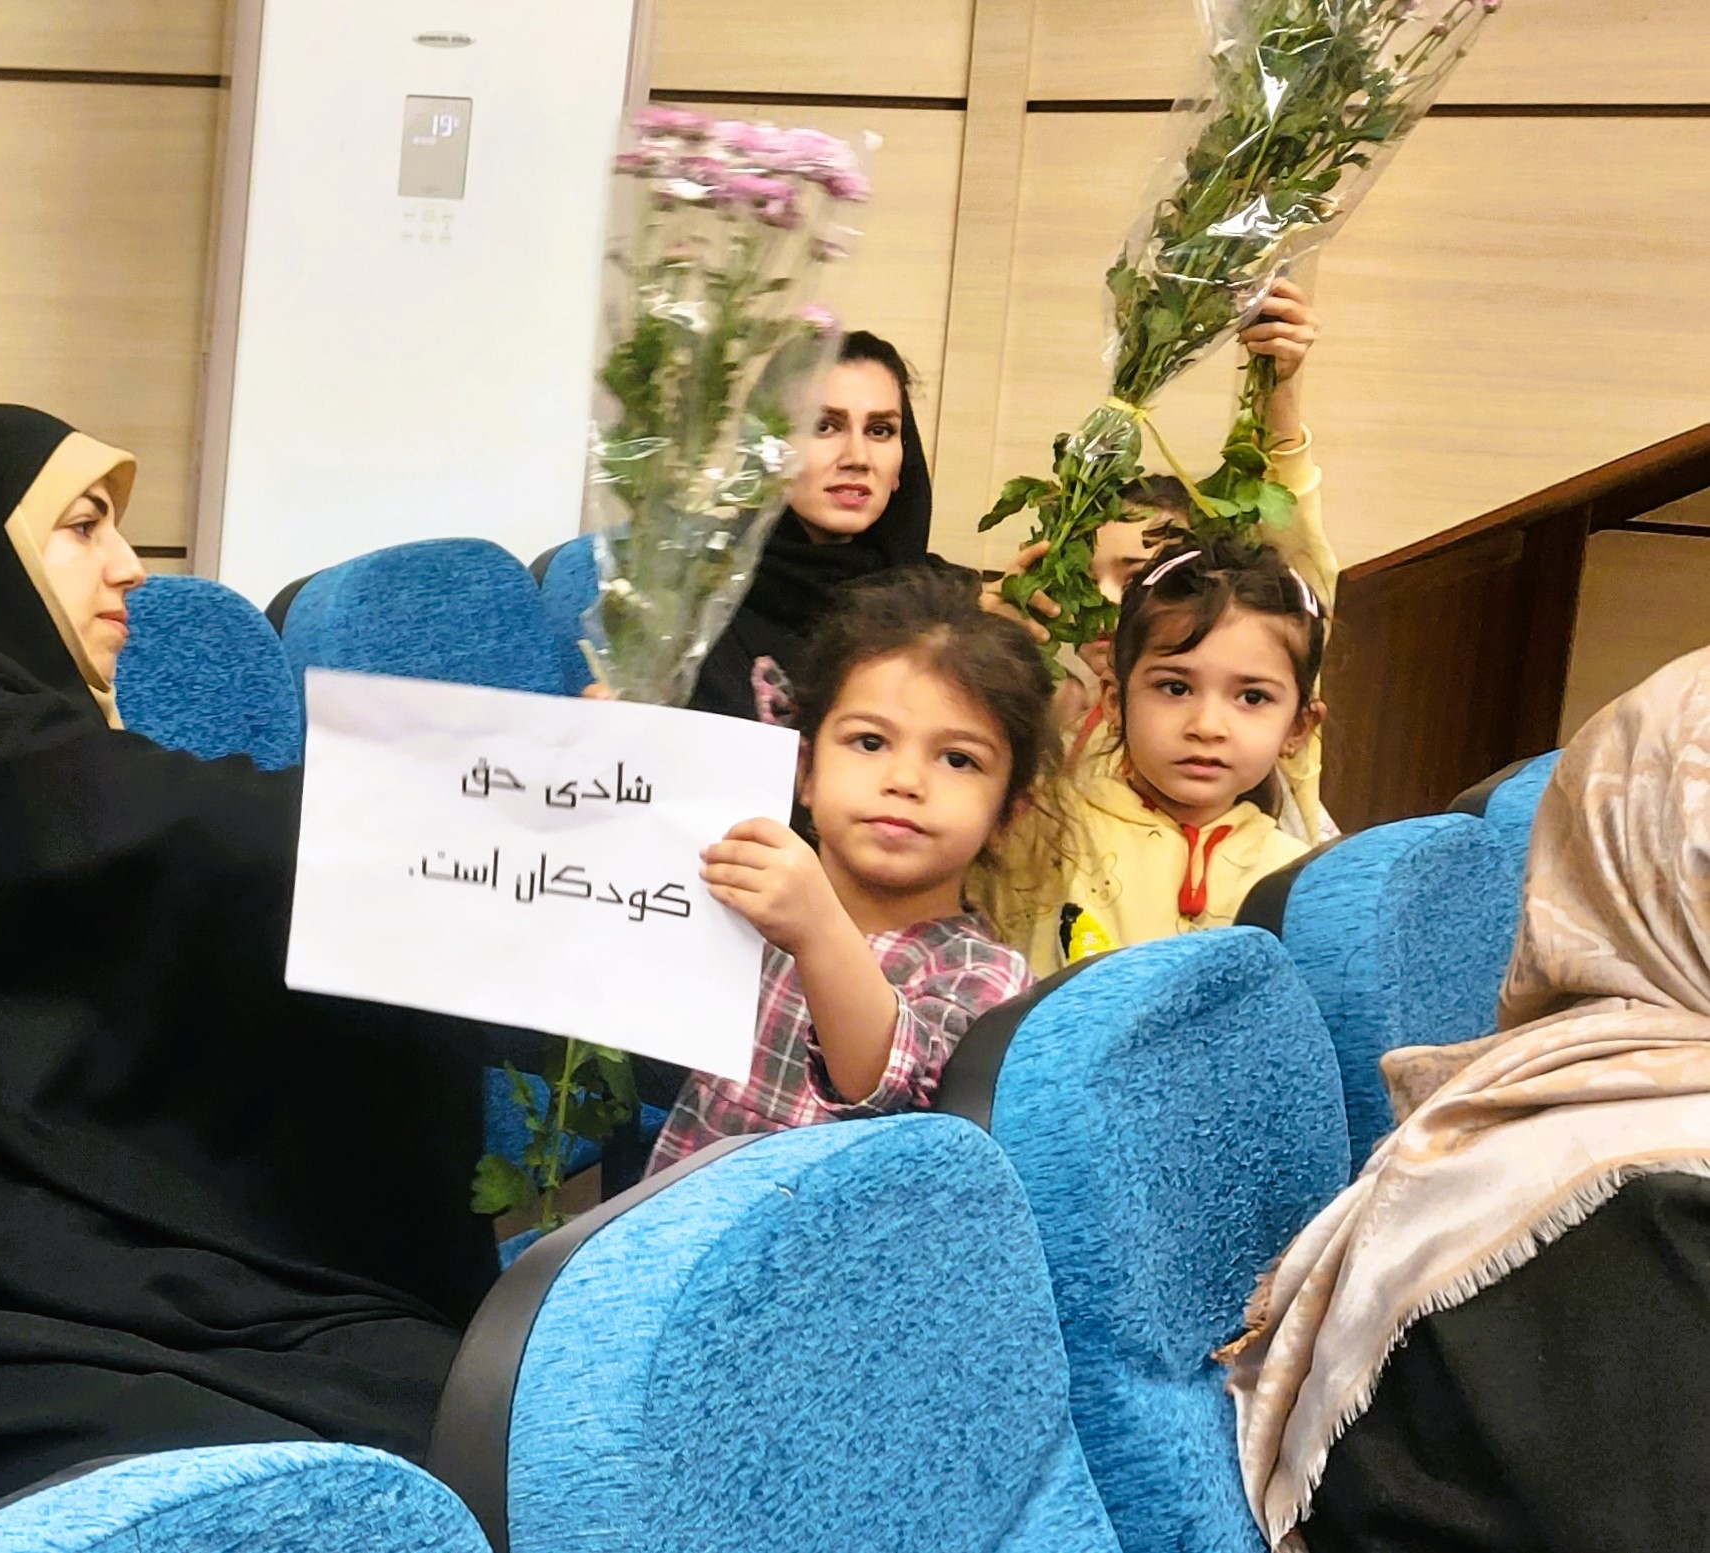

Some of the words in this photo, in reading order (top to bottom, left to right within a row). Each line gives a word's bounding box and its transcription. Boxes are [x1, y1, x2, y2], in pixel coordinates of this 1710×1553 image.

[461, 756, 527, 799] حق
[544, 759, 653, 810] شادی
[407, 846, 500, 892] است.
[515, 850, 692, 923] کودکان
